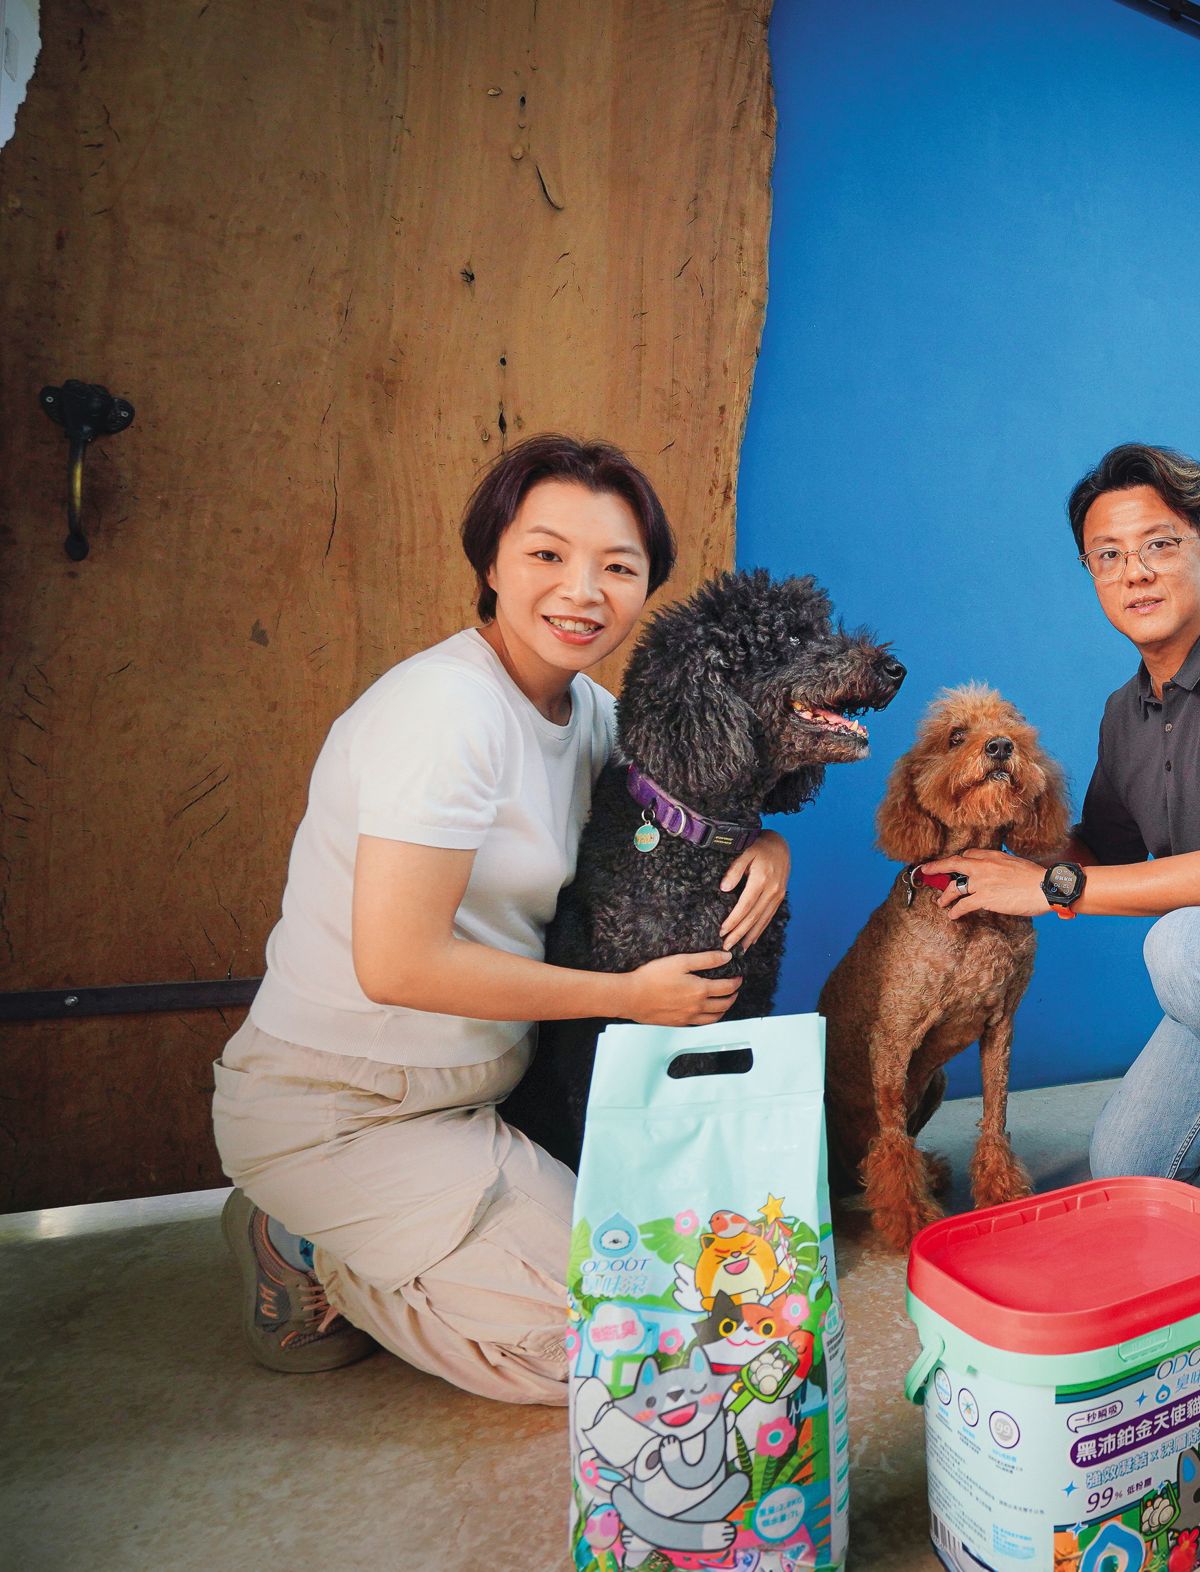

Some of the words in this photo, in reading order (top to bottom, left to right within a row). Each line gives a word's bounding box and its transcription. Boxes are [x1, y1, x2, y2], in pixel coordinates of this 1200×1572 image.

[1075, 1405, 1118, 1424] 一秒瞬吸
[1085, 1486, 1123, 1514] 99%
